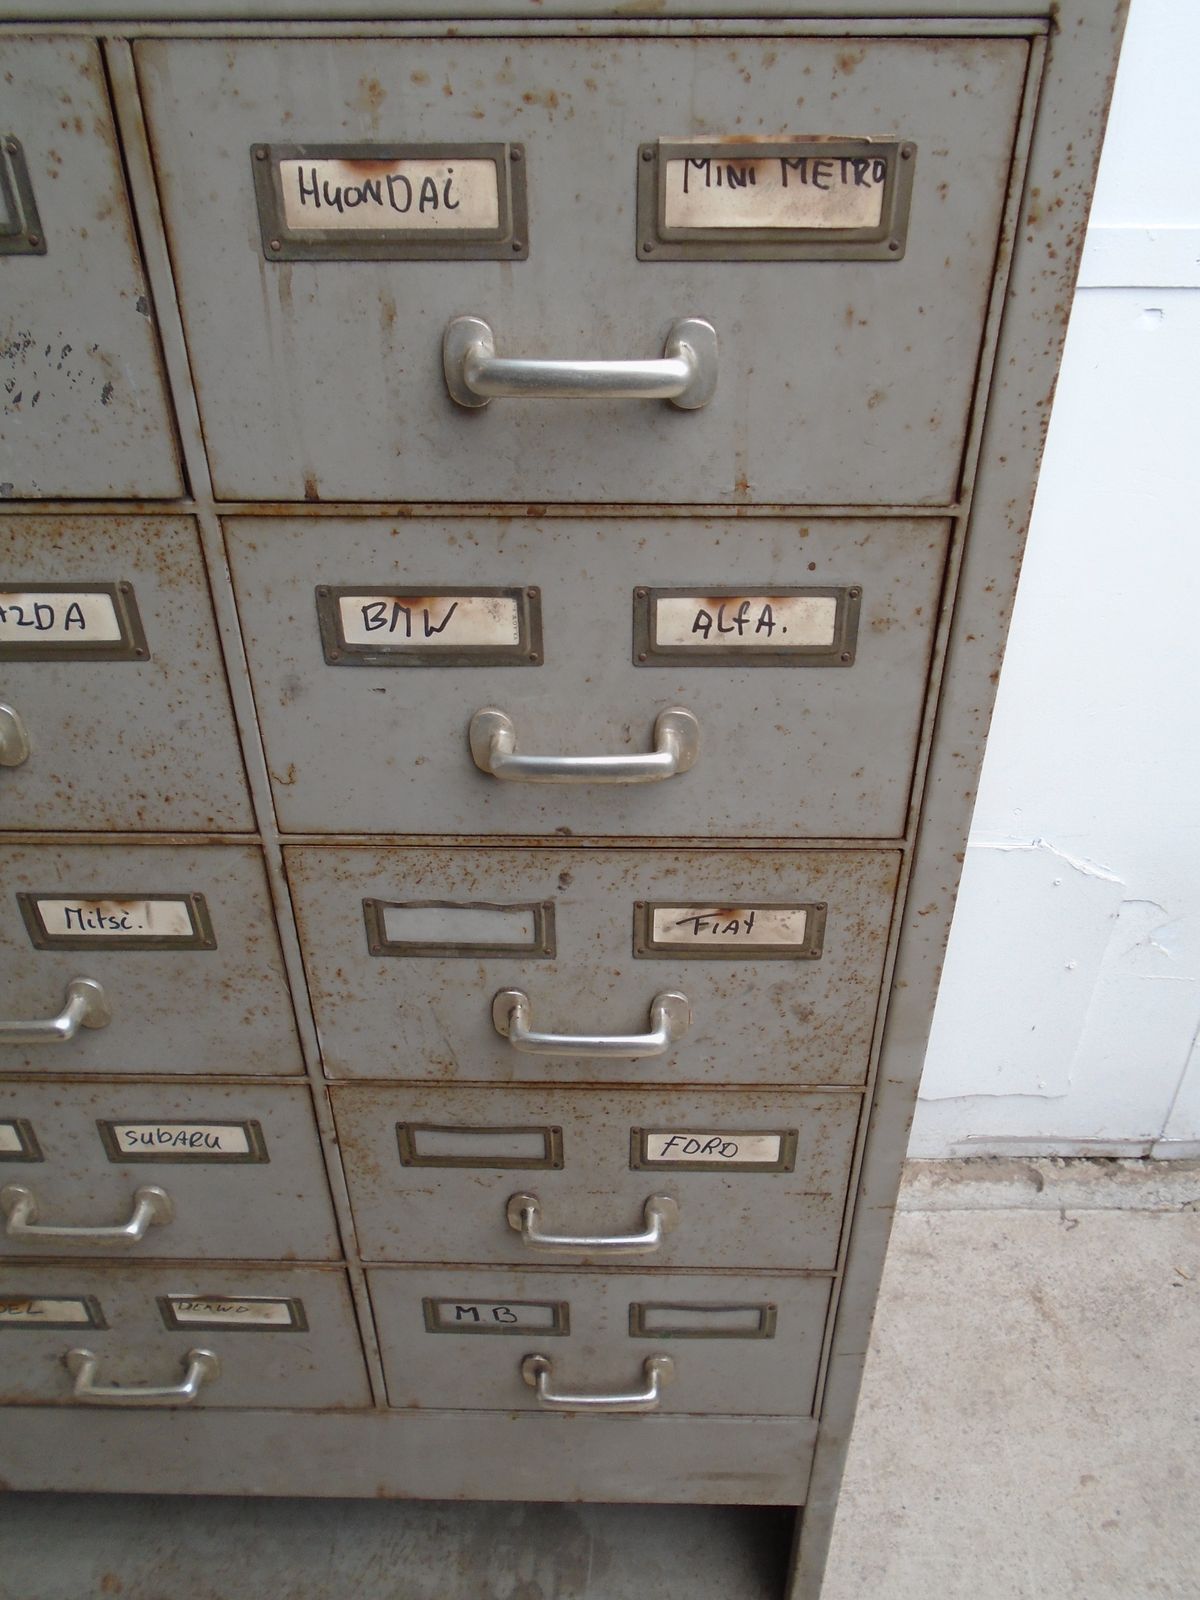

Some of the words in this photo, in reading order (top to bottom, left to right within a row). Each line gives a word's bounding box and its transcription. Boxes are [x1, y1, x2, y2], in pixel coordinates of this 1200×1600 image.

[780, 156, 887, 190] METRO
[360, 601, 459, 638] BMW
[659, 1135, 740, 1158] FORD
